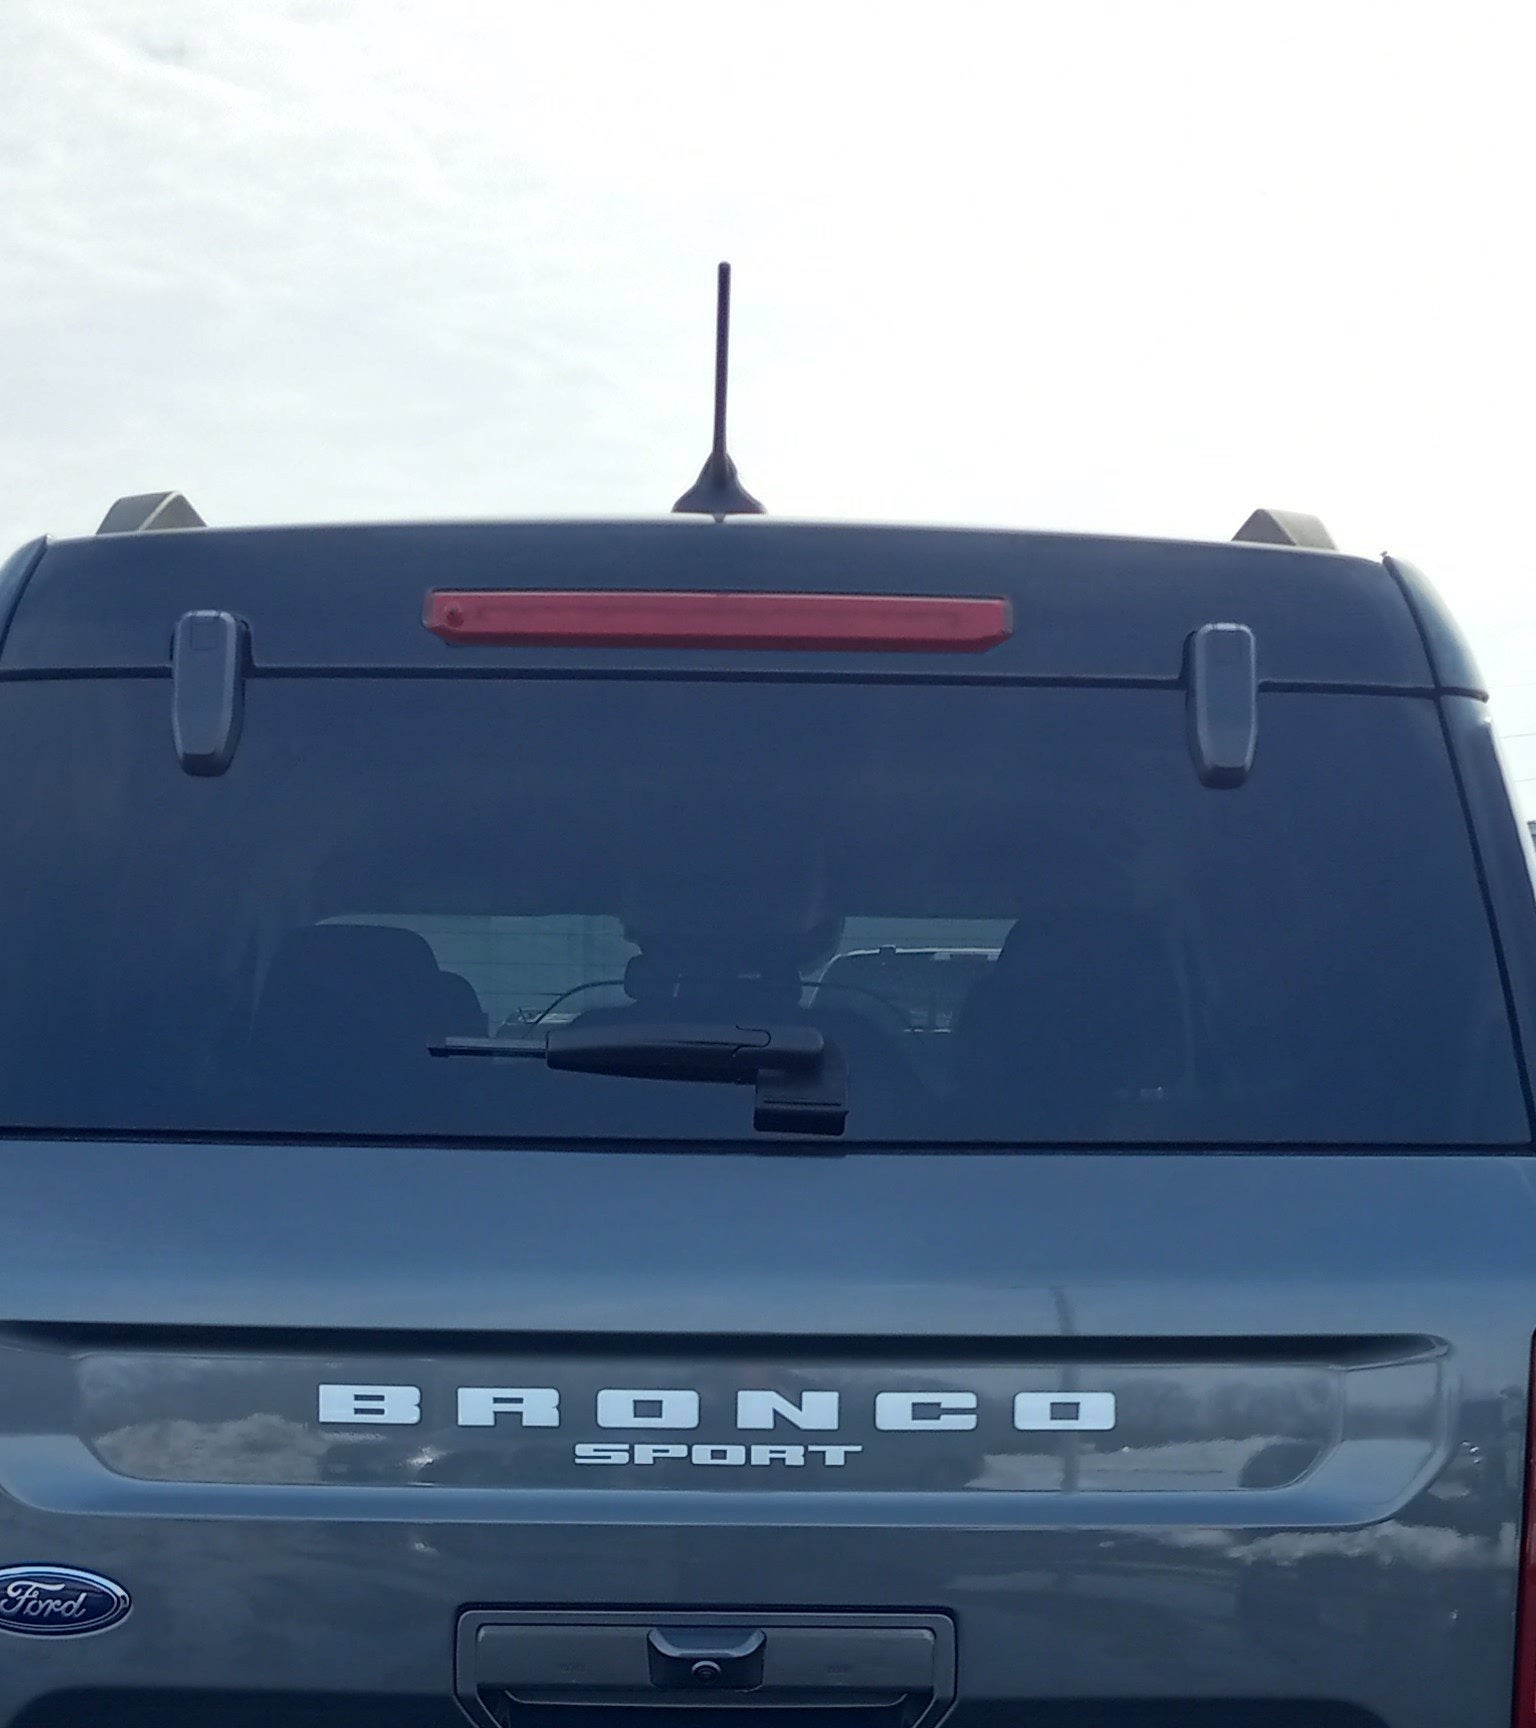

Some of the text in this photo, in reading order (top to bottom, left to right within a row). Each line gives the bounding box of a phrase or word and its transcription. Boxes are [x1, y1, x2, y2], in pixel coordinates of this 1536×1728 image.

[319, 1384, 1116, 1431] BRONCO
[574, 1443, 862, 1467] SPORT
[0, 1580, 87, 1618] Ford
